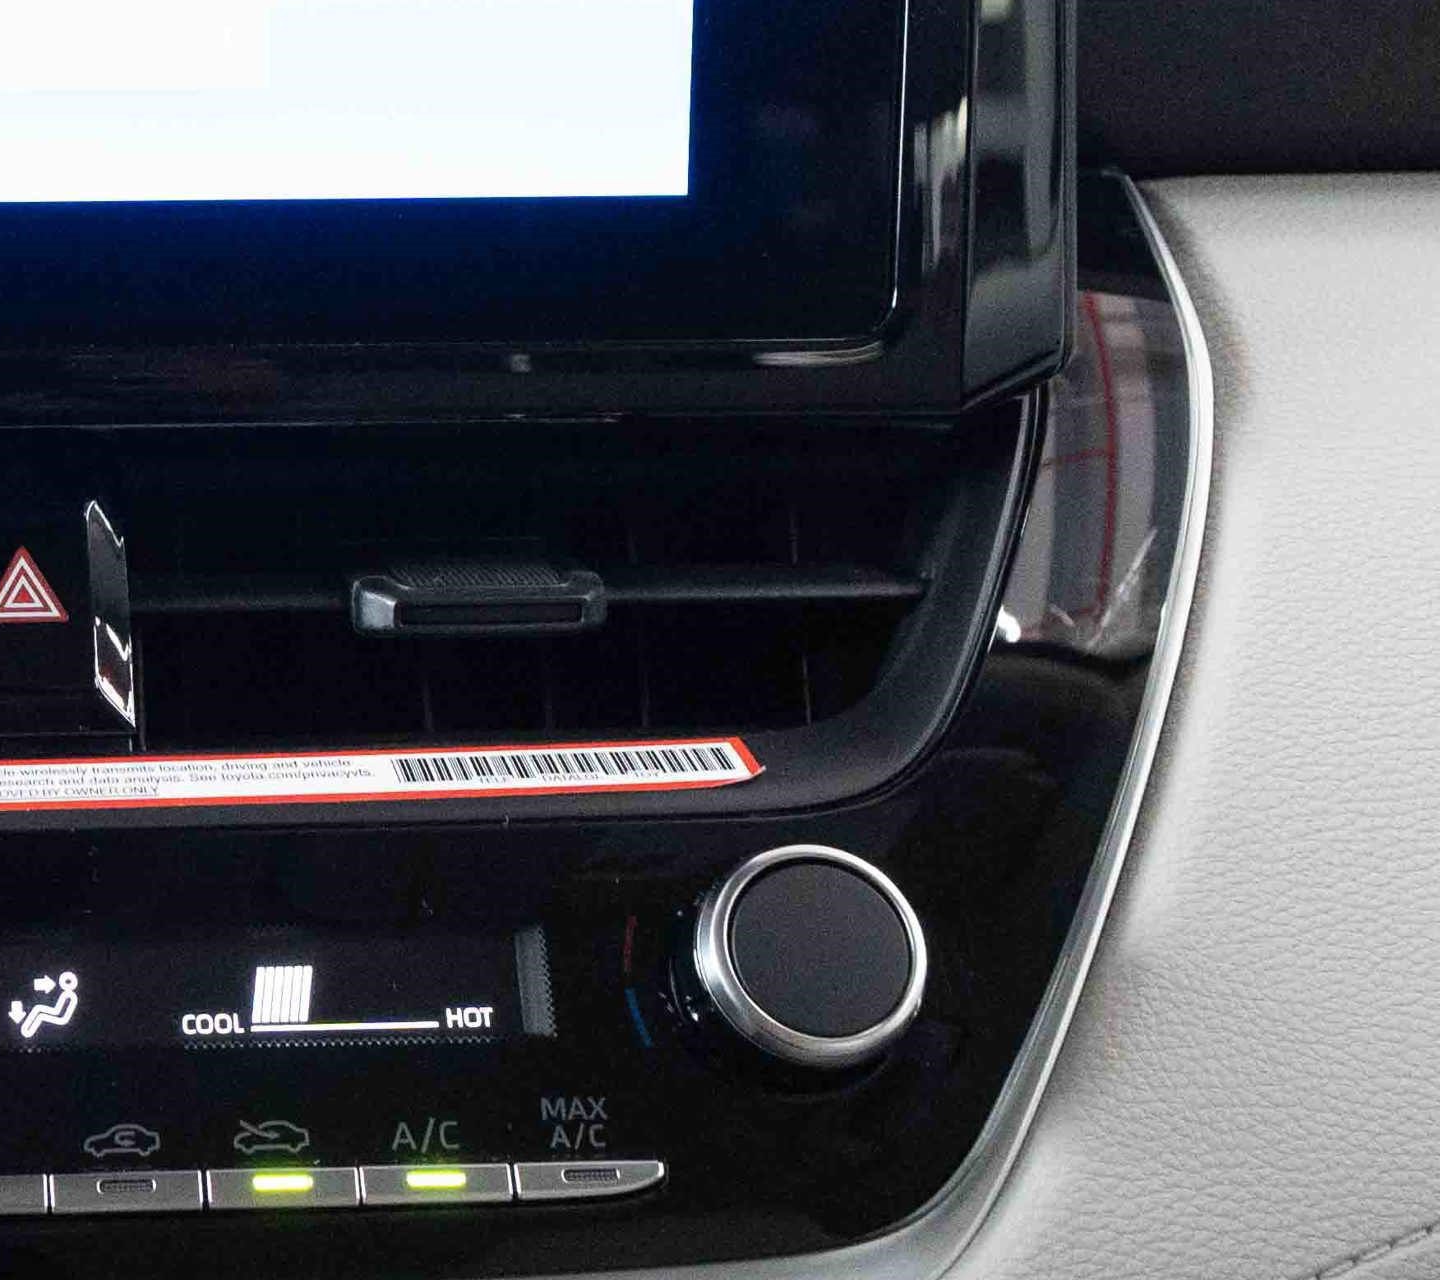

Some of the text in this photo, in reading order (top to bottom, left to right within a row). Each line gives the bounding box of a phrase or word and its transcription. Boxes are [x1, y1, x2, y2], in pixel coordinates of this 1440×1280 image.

[182, 1006, 493, 1036] COOL HOT
[540, 1097, 607, 1122] MAX
[392, 1118, 460, 1153] A/C
[550, 1121, 607, 1150] A/C
